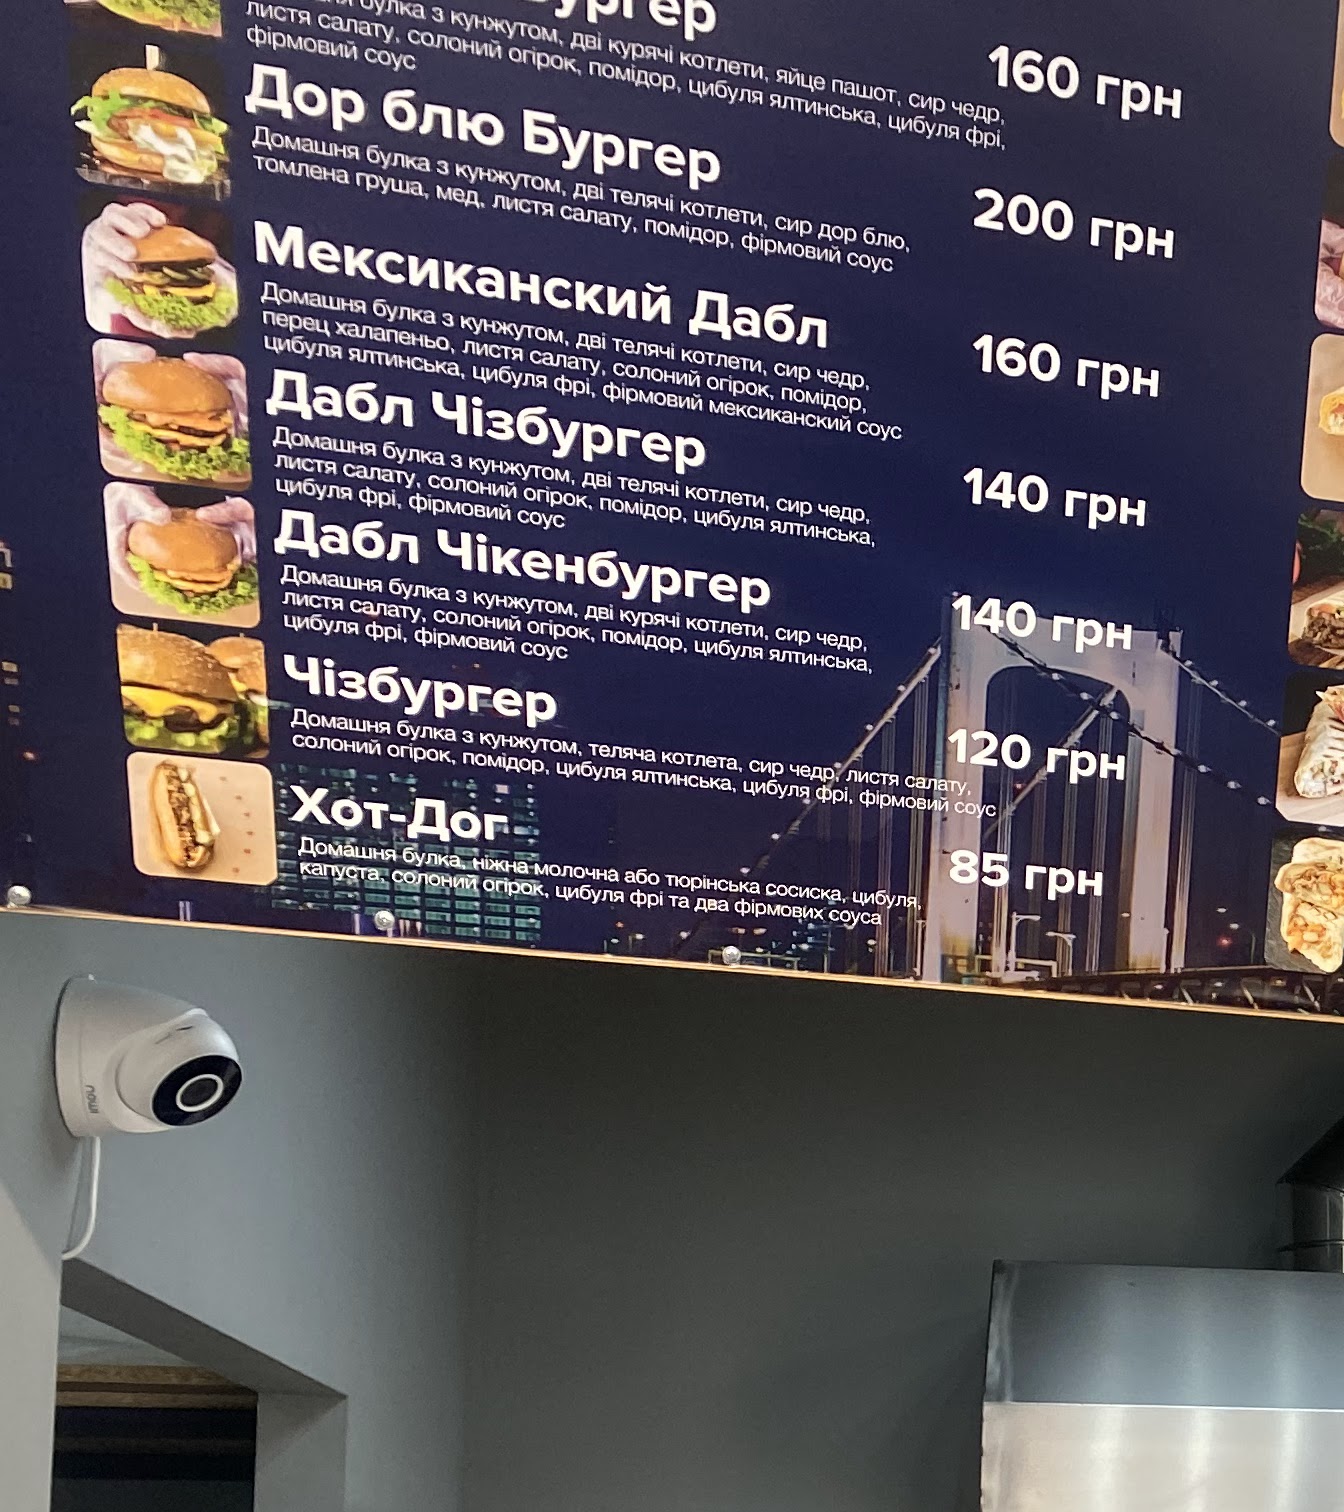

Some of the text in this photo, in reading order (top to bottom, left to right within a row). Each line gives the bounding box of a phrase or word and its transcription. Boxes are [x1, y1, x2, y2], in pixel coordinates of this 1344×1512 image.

[245, 64, 720, 190] Дор блю Бургер
[252, 126, 909, 252] Домашня булка з кунжутом, дві телячі котлети, сир дор блю,
[974, 189, 1173, 260] 200 грн
[255, 221, 826, 348] Мексиканский Дабл
[290, 786, 508, 841] Хот-Дог
[298, 837, 921, 912] Домашня булка, ніжна молочна або тюрінська сосиска, цибуля,
[950, 850, 1102, 900] 85 грн
